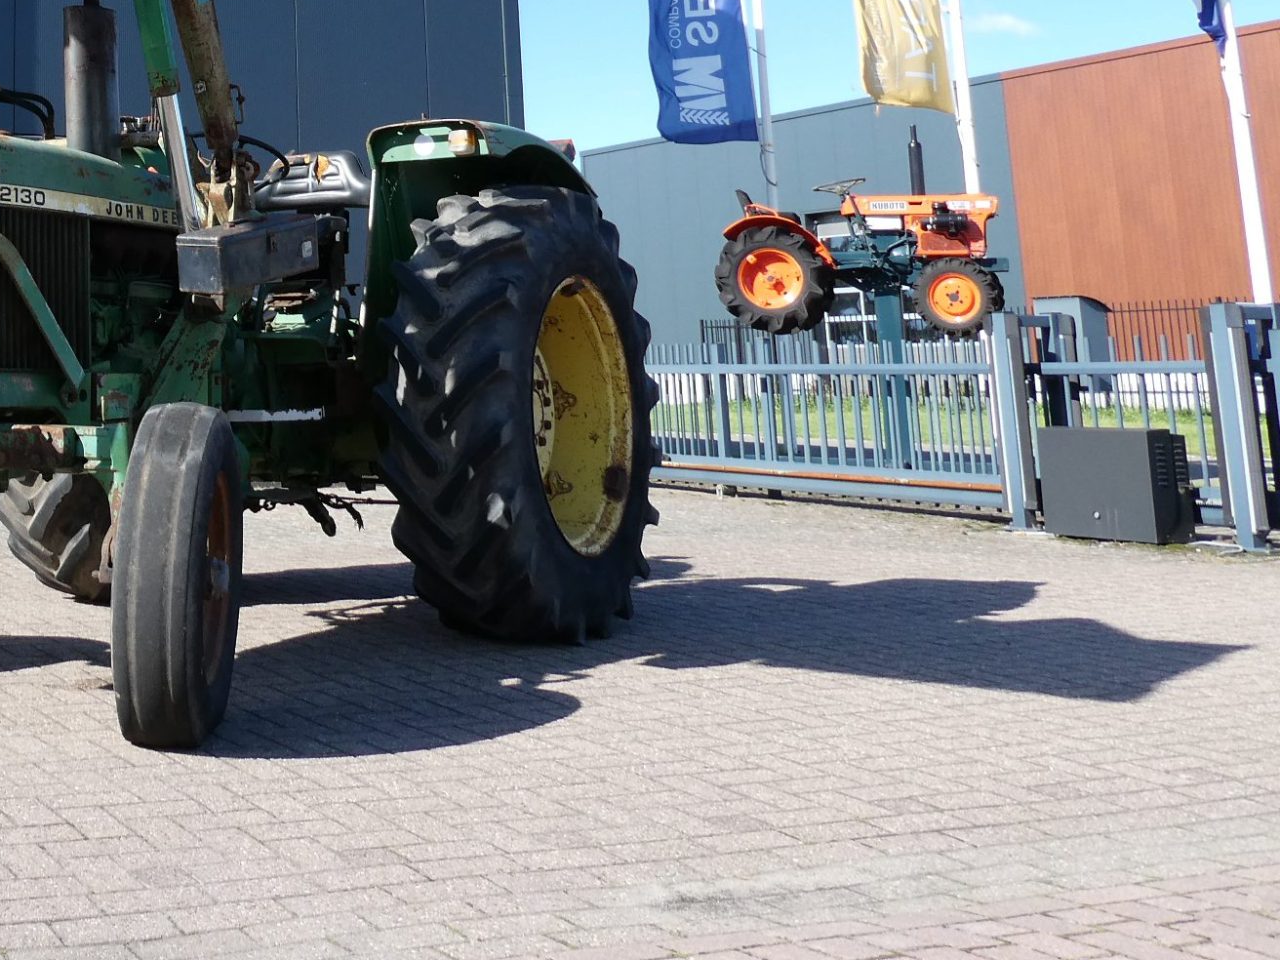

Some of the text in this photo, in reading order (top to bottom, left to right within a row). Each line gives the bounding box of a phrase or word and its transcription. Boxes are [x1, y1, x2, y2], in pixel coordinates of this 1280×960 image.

[0, 186, 46, 206] 2130
[106, 201, 177, 225] JOHN DEE
